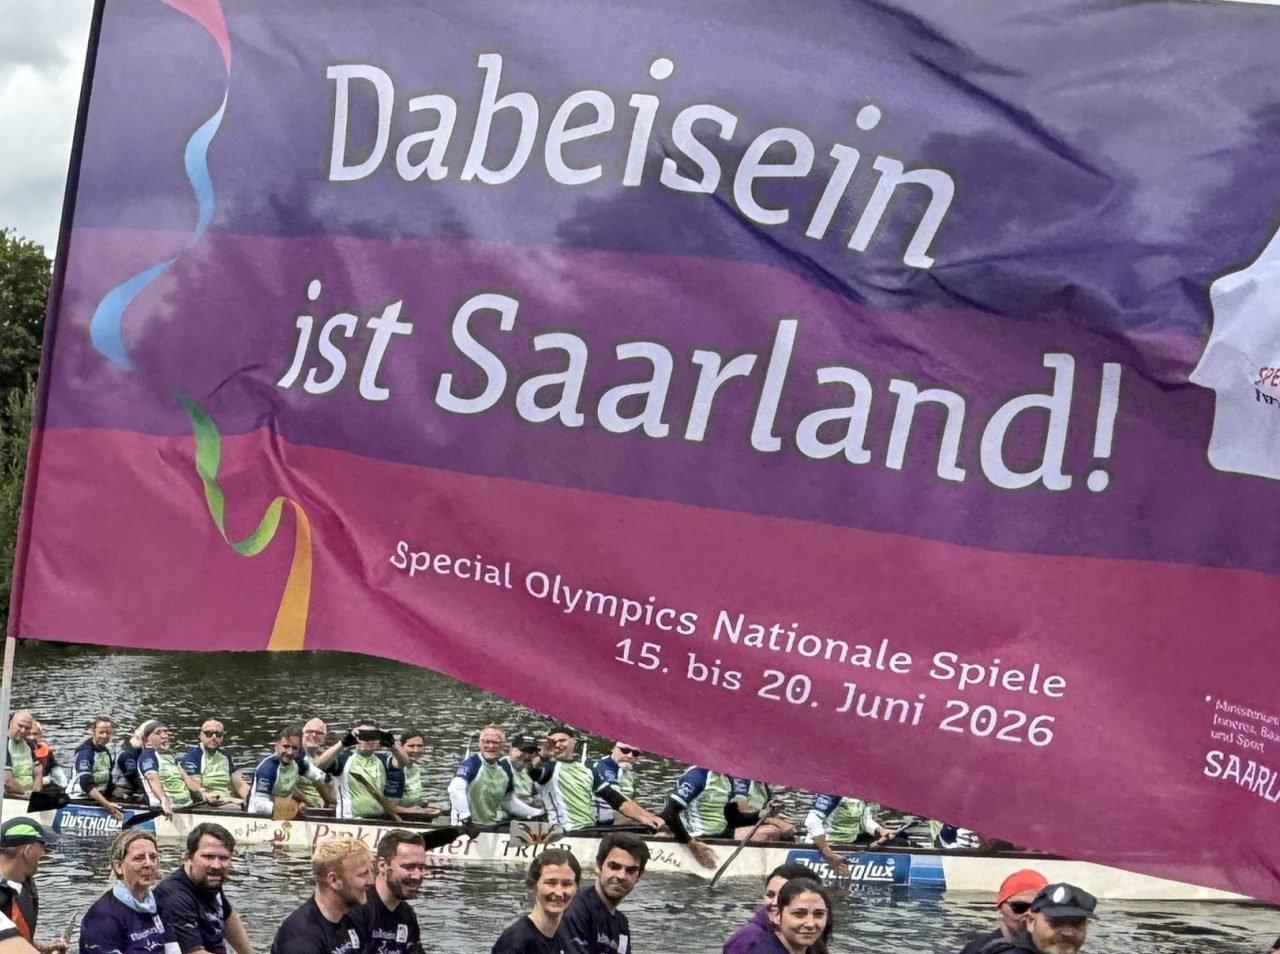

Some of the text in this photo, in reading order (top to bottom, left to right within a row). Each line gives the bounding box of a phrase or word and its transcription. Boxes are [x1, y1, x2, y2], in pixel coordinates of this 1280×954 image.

[325, 53, 955, 269] Dabeisein
[277, 279, 1122, 492] ist Saarland!
[389, 540, 1067, 698] Special Olympics Nationale Spiele
[614, 638, 1056, 748] 15. bis 20. Juni 2026
[1203, 750, 1280, 803] SAARL
